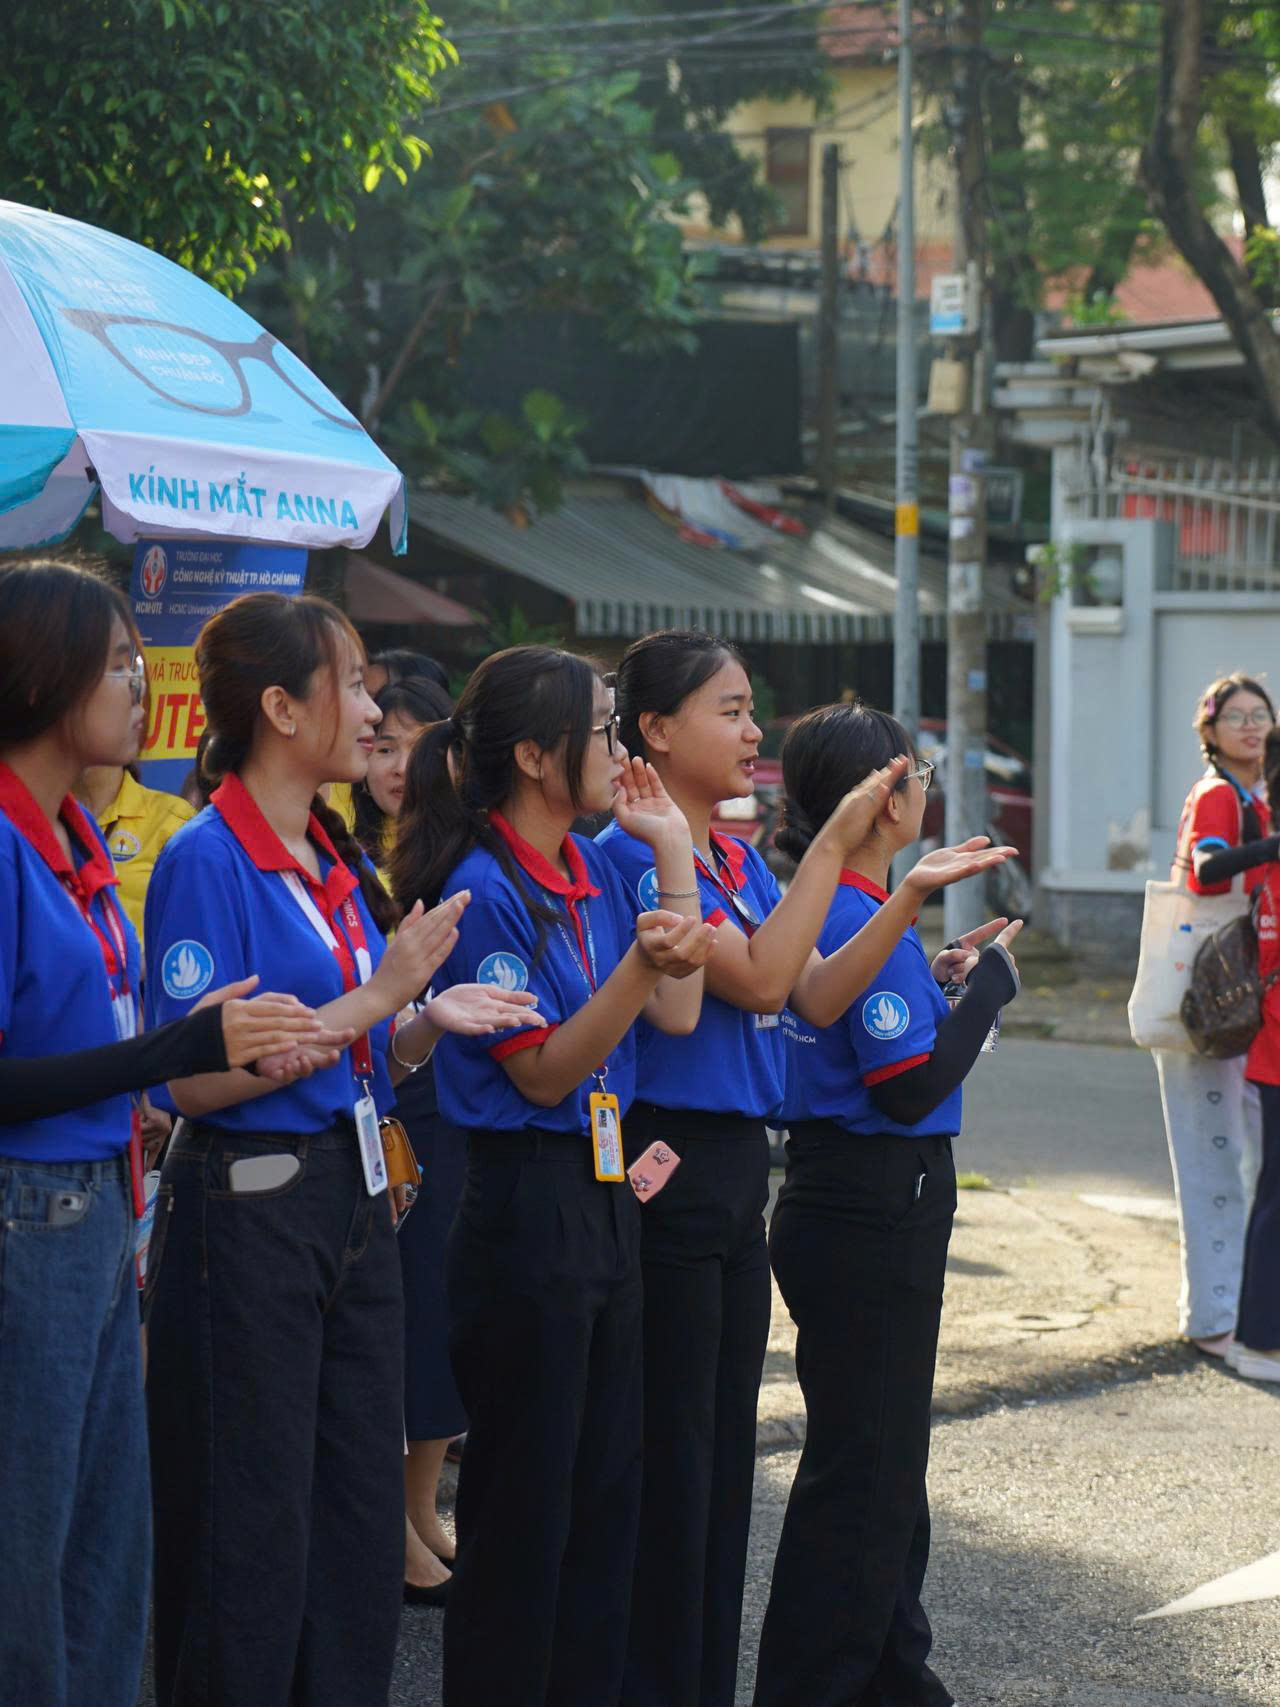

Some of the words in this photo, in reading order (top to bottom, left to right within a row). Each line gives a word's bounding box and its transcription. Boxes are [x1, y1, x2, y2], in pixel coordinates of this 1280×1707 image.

[129, 465, 200, 511] KÍNH
[208, 472, 267, 518] MẮT
[277, 491, 359, 529] ANNA
[226, 569, 249, 587] THUẬT
